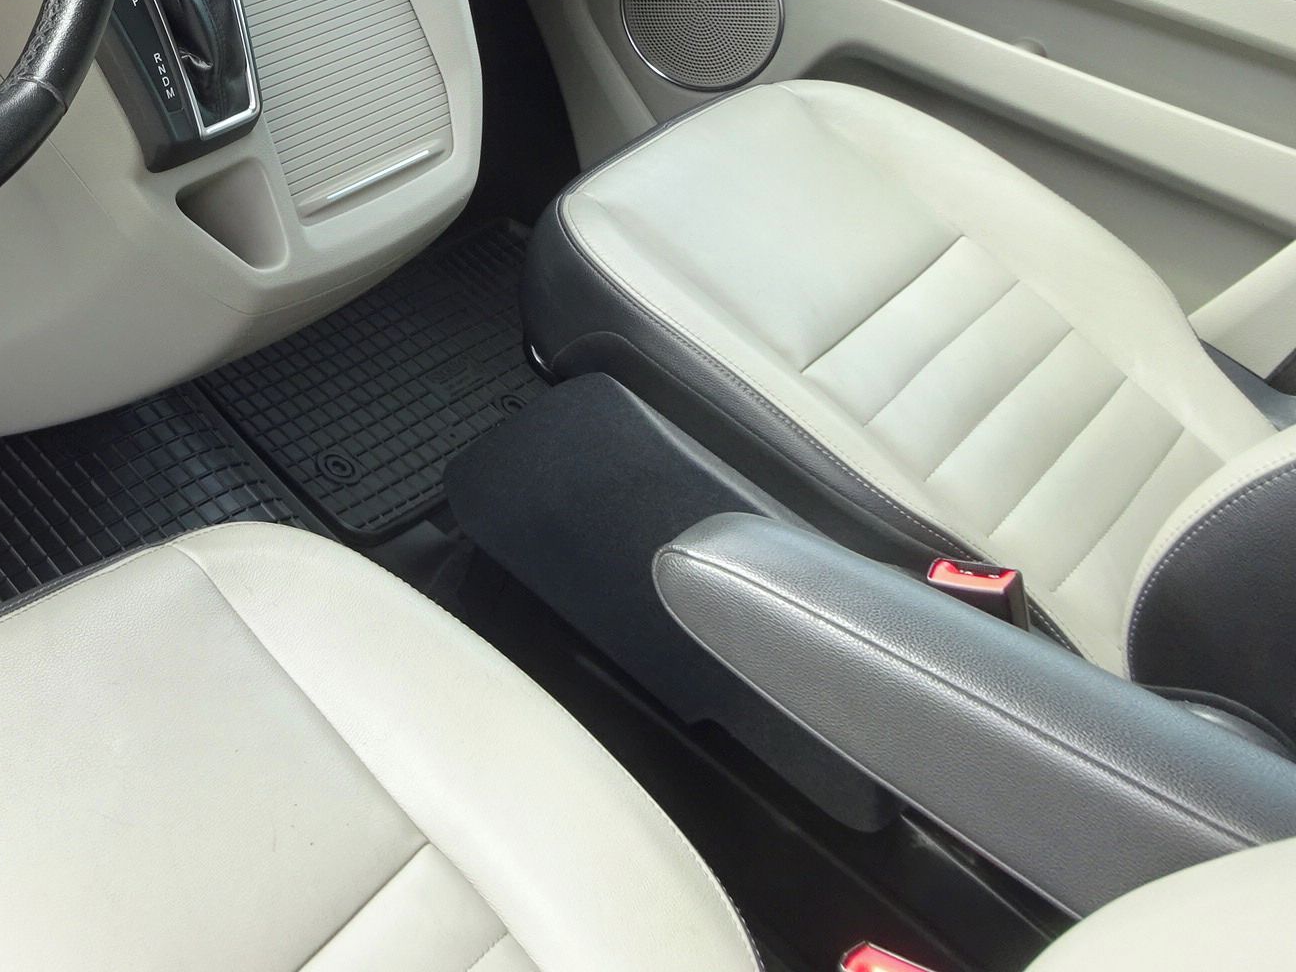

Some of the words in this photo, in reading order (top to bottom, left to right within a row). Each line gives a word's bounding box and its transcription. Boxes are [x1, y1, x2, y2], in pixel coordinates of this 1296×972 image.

[153, 53, 162, 63] R
[158, 64, 166, 75] N
[162, 76, 170, 87] D
[165, 87, 175, 99] M
